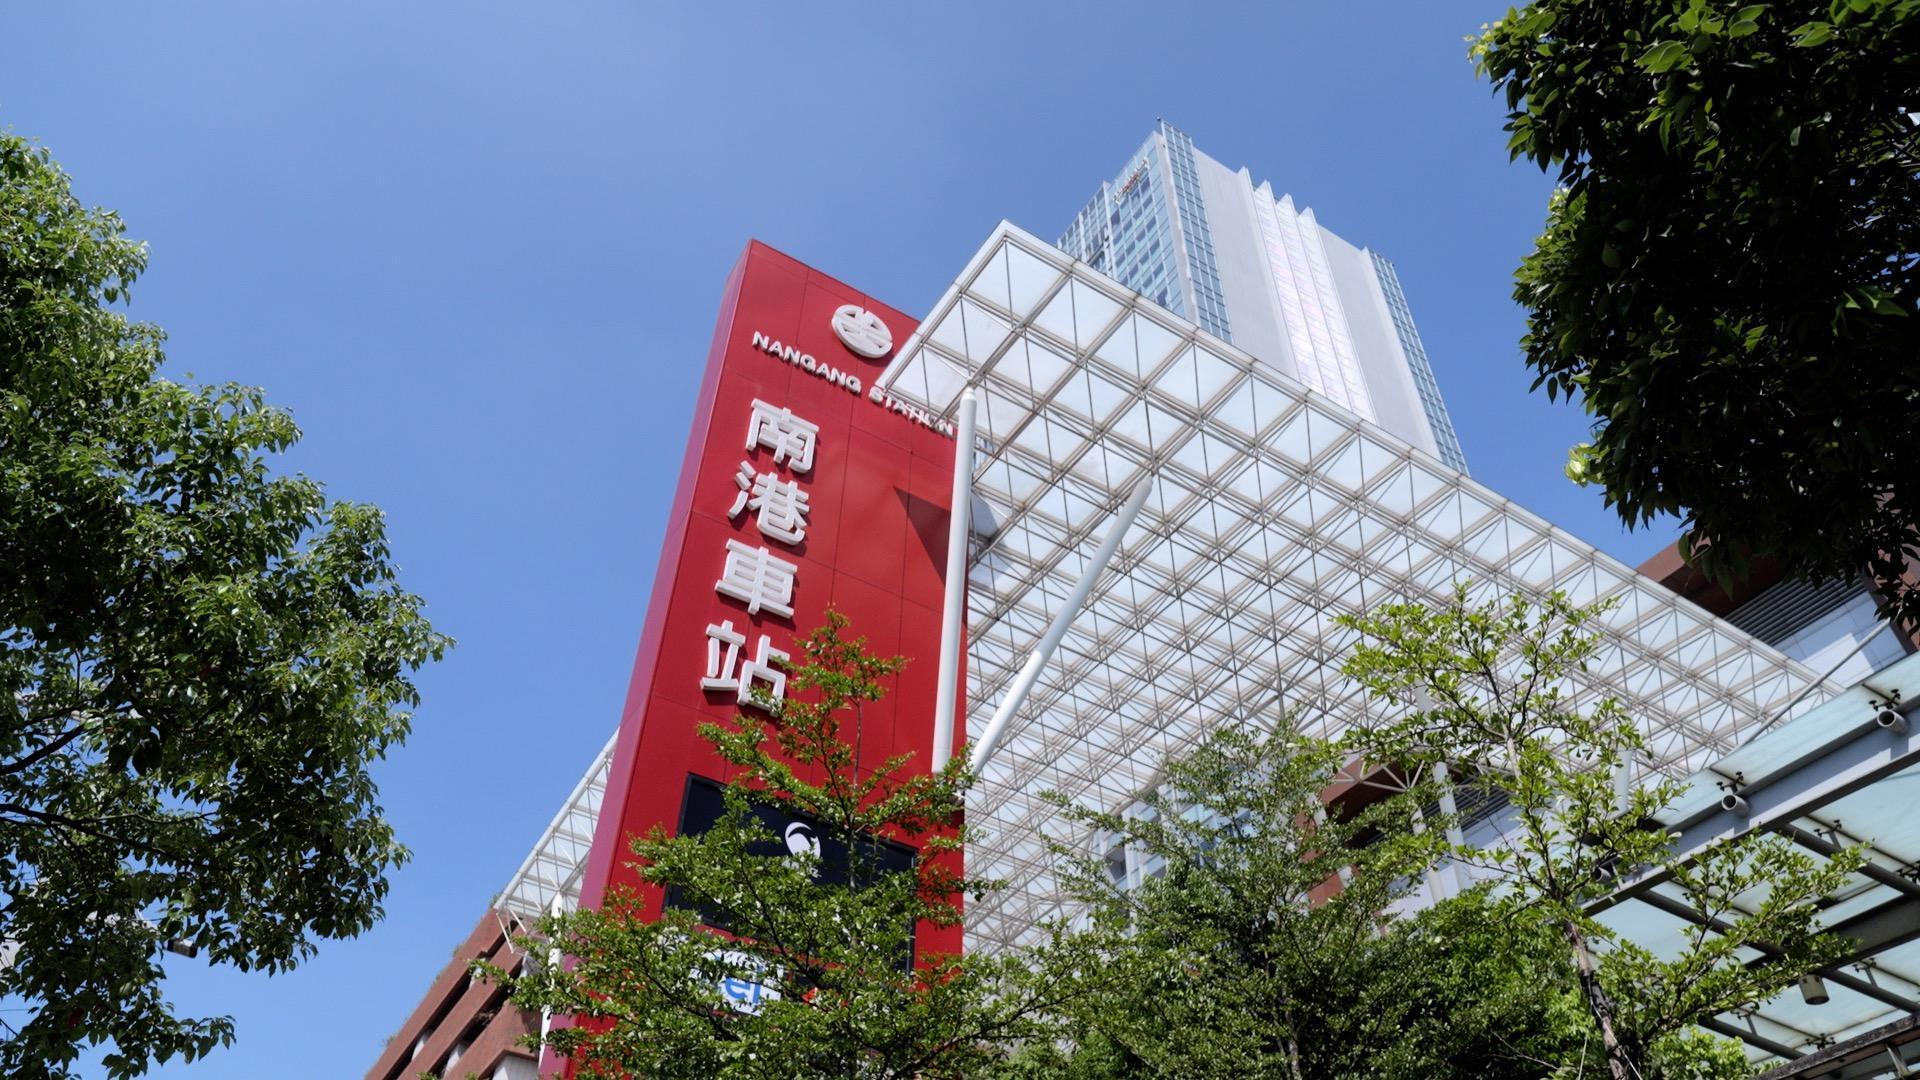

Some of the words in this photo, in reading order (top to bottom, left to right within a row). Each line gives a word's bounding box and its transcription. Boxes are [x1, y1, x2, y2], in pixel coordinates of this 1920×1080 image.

[752, 331, 862, 394] NANGANG
[699, 398, 819, 717] 南港車站
